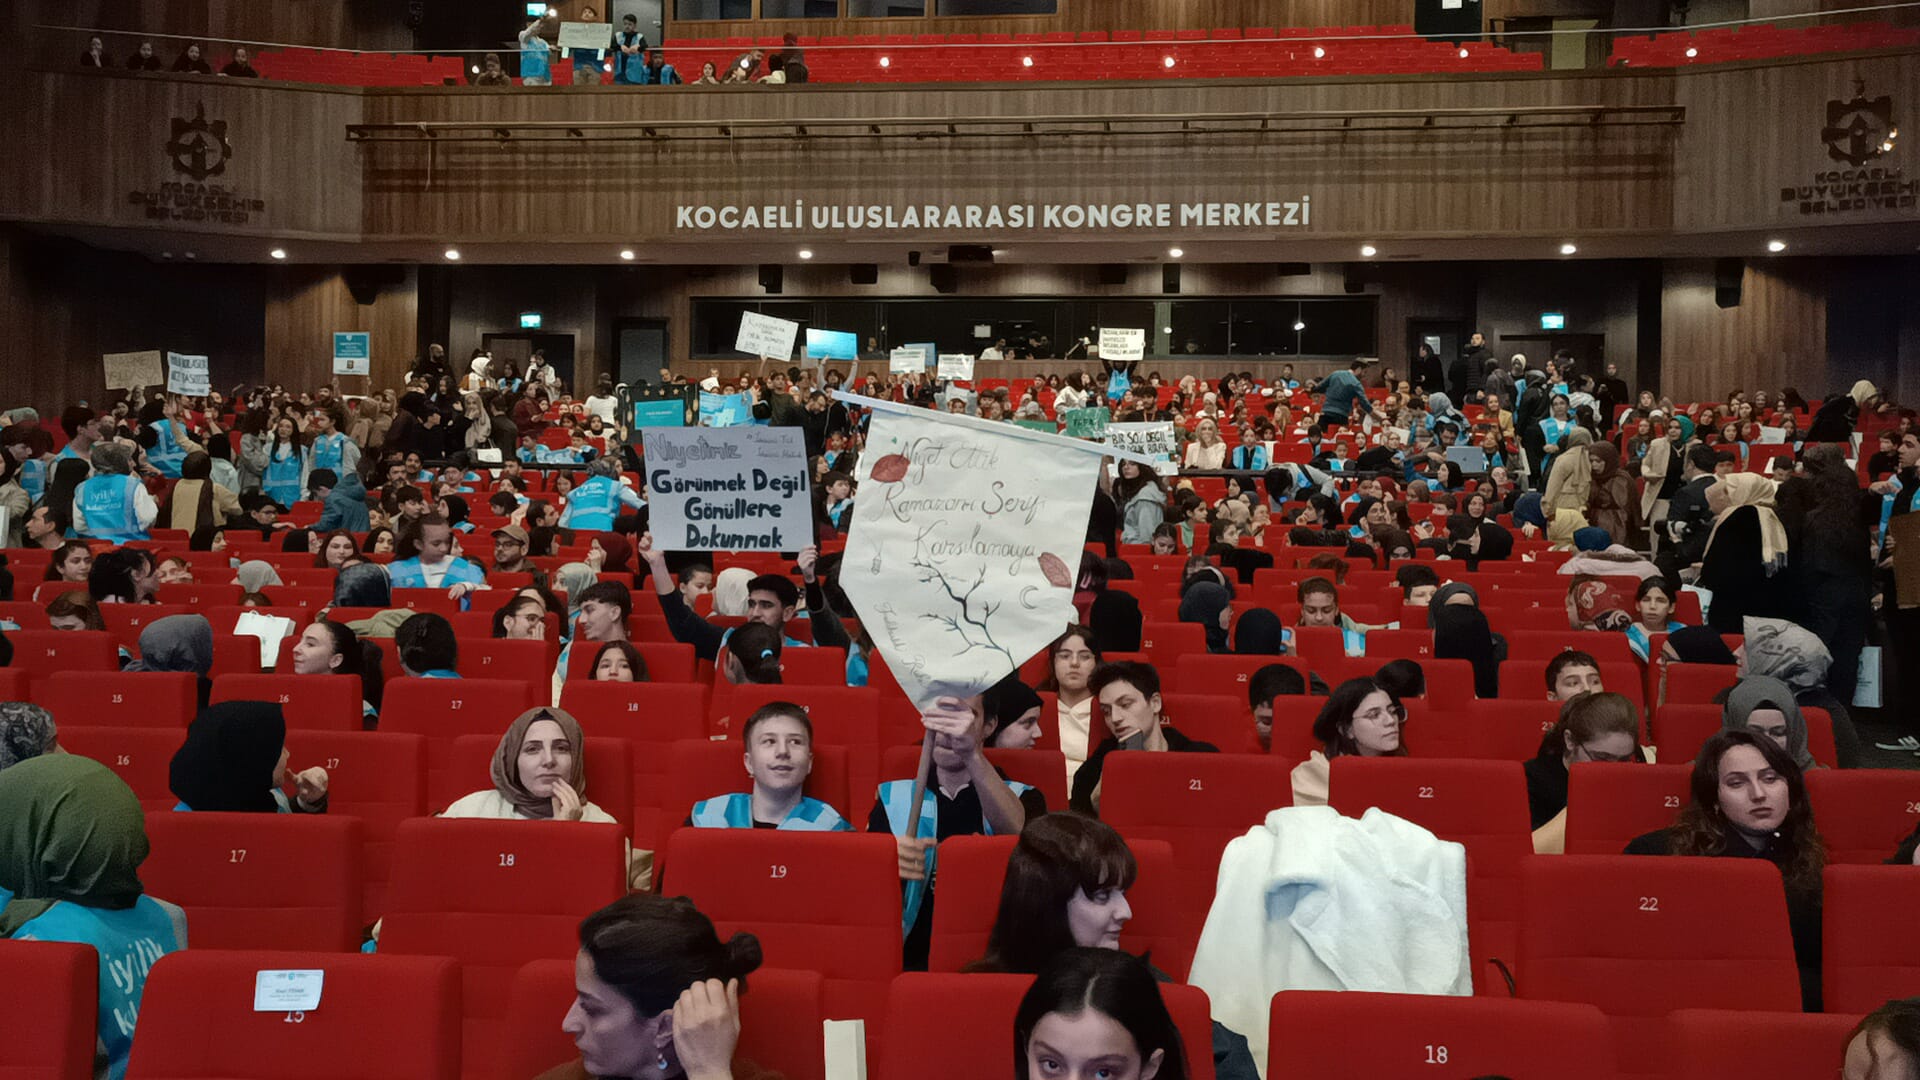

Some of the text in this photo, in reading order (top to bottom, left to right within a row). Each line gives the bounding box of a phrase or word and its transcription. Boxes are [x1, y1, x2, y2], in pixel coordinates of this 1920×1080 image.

[676, 195, 1310, 230] KOCAELİ ULUSLARARASI KONGRE MERKEZİ
[644, 432, 742, 468] Niyetimiz
[650, 468, 806, 498] Görünmek Değil
[684, 496, 783, 521] Gönüllere
[685, 523, 783, 549] Dokunmak
[483, 656, 492, 665] 17
[1236, 673, 1248, 682] 22
[111, 694, 123, 704] 15
[279, 694, 290, 704] 16
[451, 700, 462, 710] 17
[628, 702, 639, 712] 18
[117, 754, 130, 766] 16
[326, 758, 340, 770] 17
[1189, 778, 1203, 791] 21
[1418, 786, 1434, 799] 22
[1664, 796, 1680, 808] 23
[229, 849, 247, 863] 17
[499, 853, 515, 867] 18
[770, 865, 787, 879] 19
[1639, 896, 1659, 912] 22
[1425, 1044, 1448, 1064] 18
